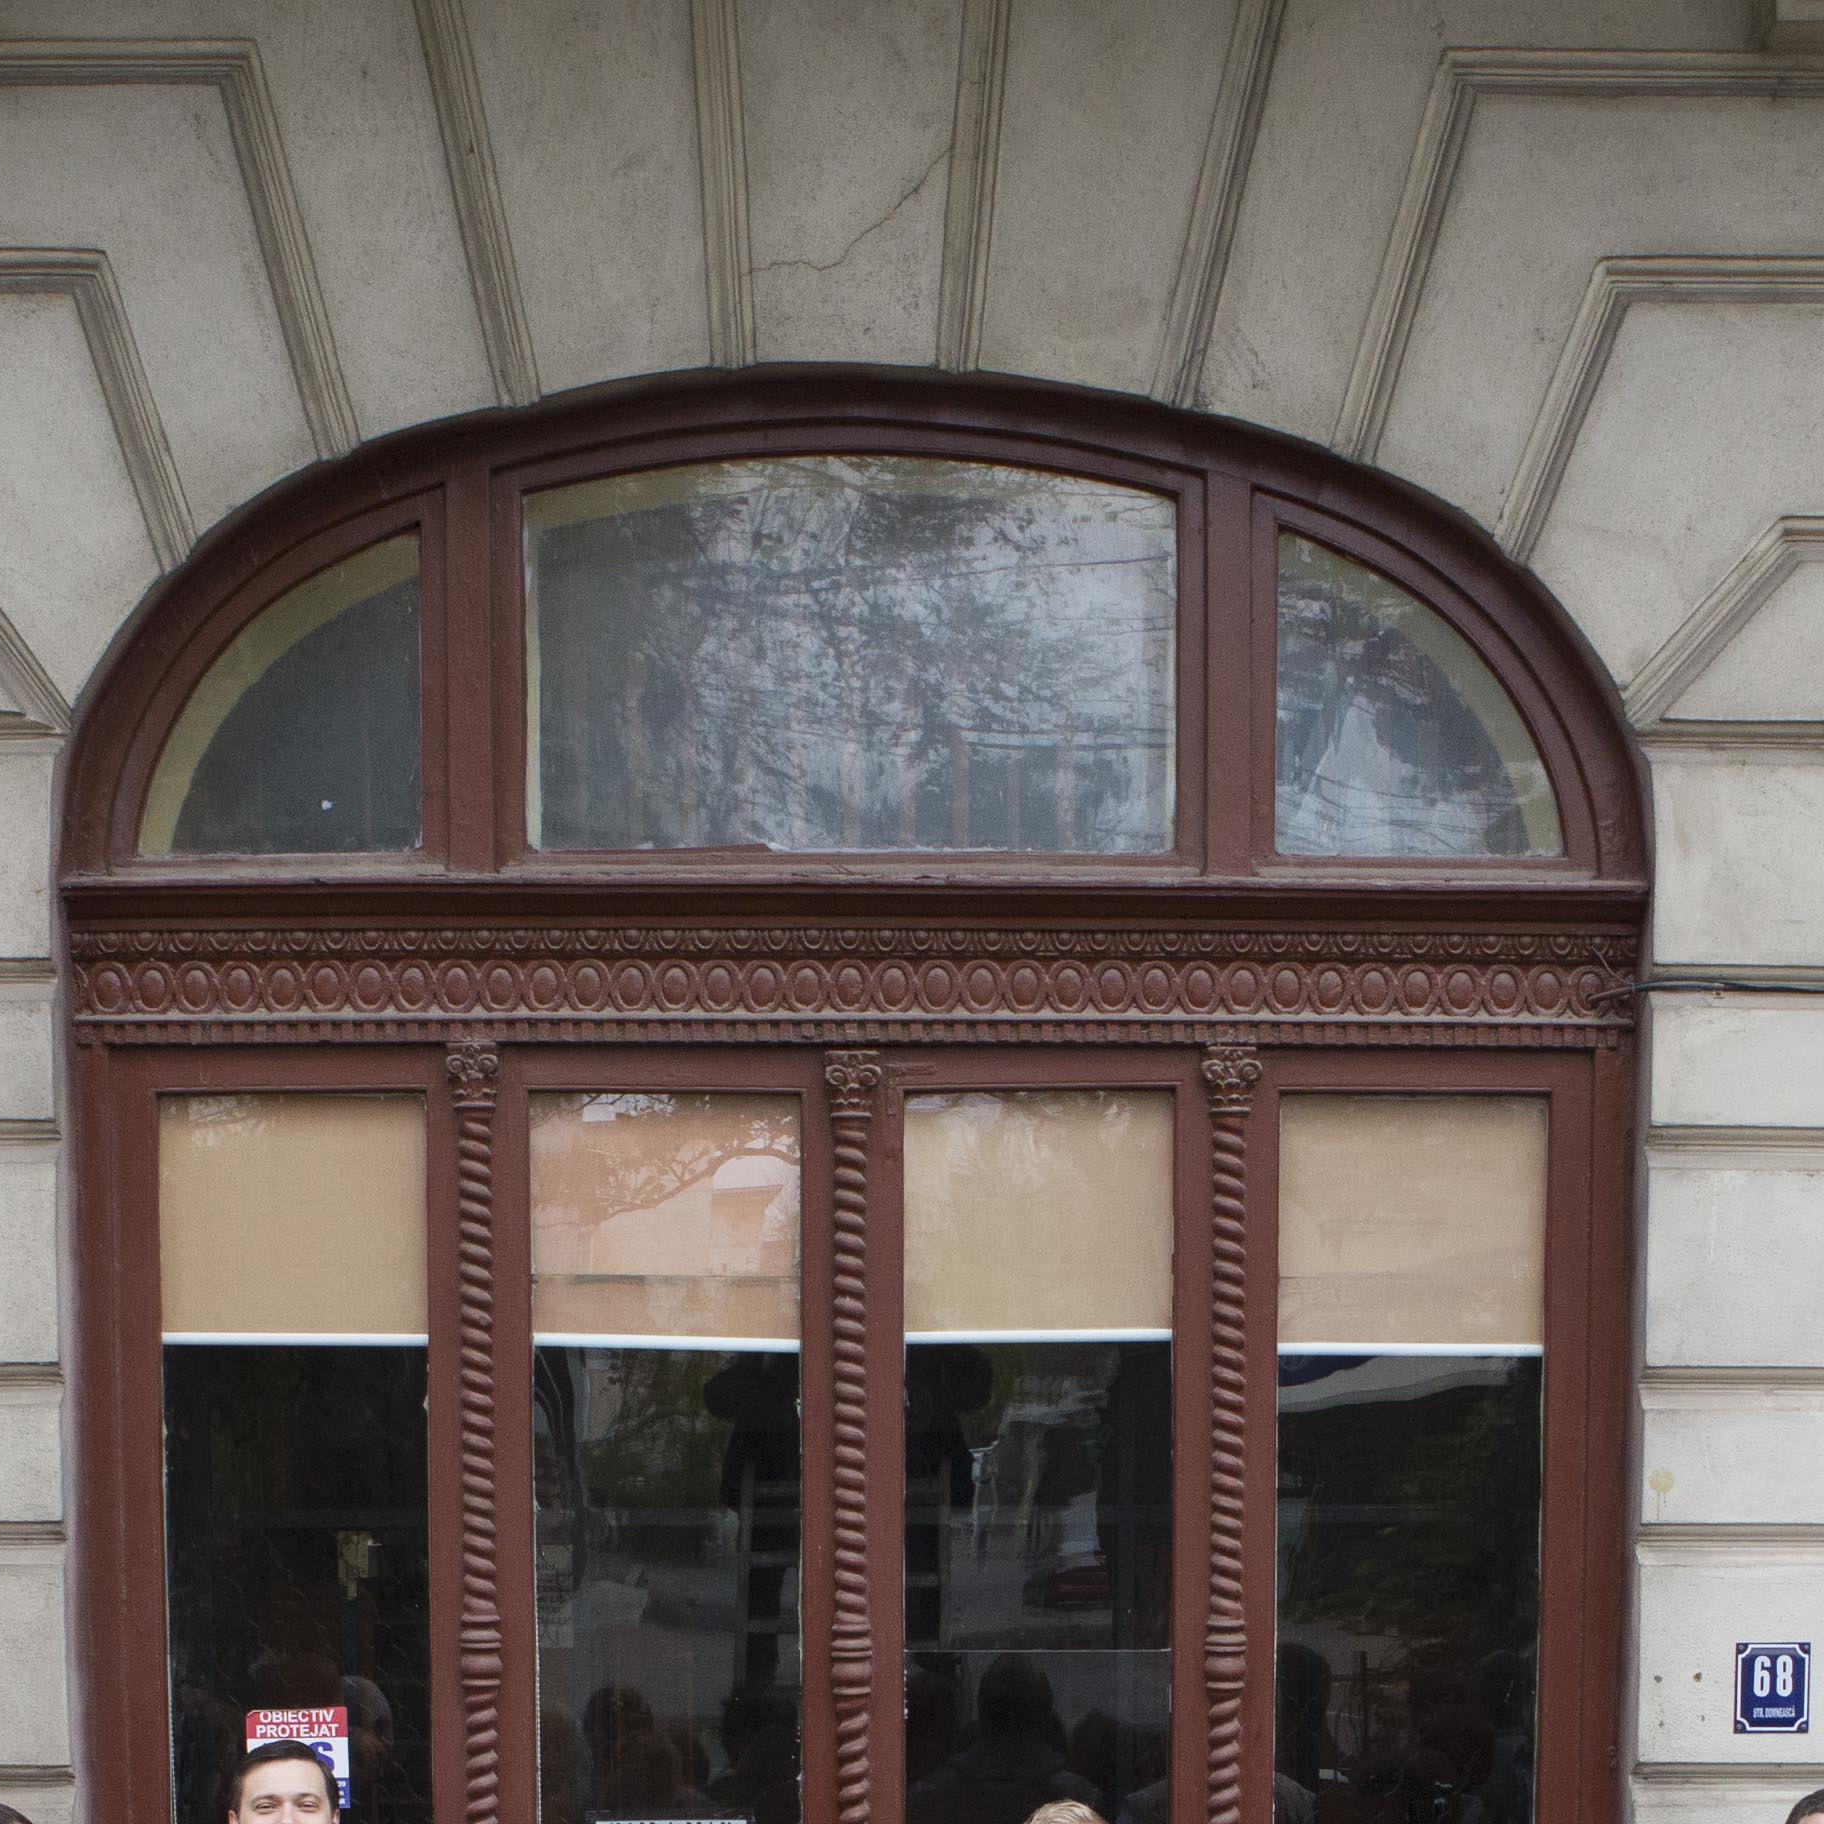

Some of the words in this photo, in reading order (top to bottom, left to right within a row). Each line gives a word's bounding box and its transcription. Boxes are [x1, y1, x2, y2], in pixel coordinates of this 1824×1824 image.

[1753, 1655, 1793, 1697] 68
[259, 1710, 335, 1723] OBIECTIV
[256, 1724, 339, 1738] PROTEJAT
